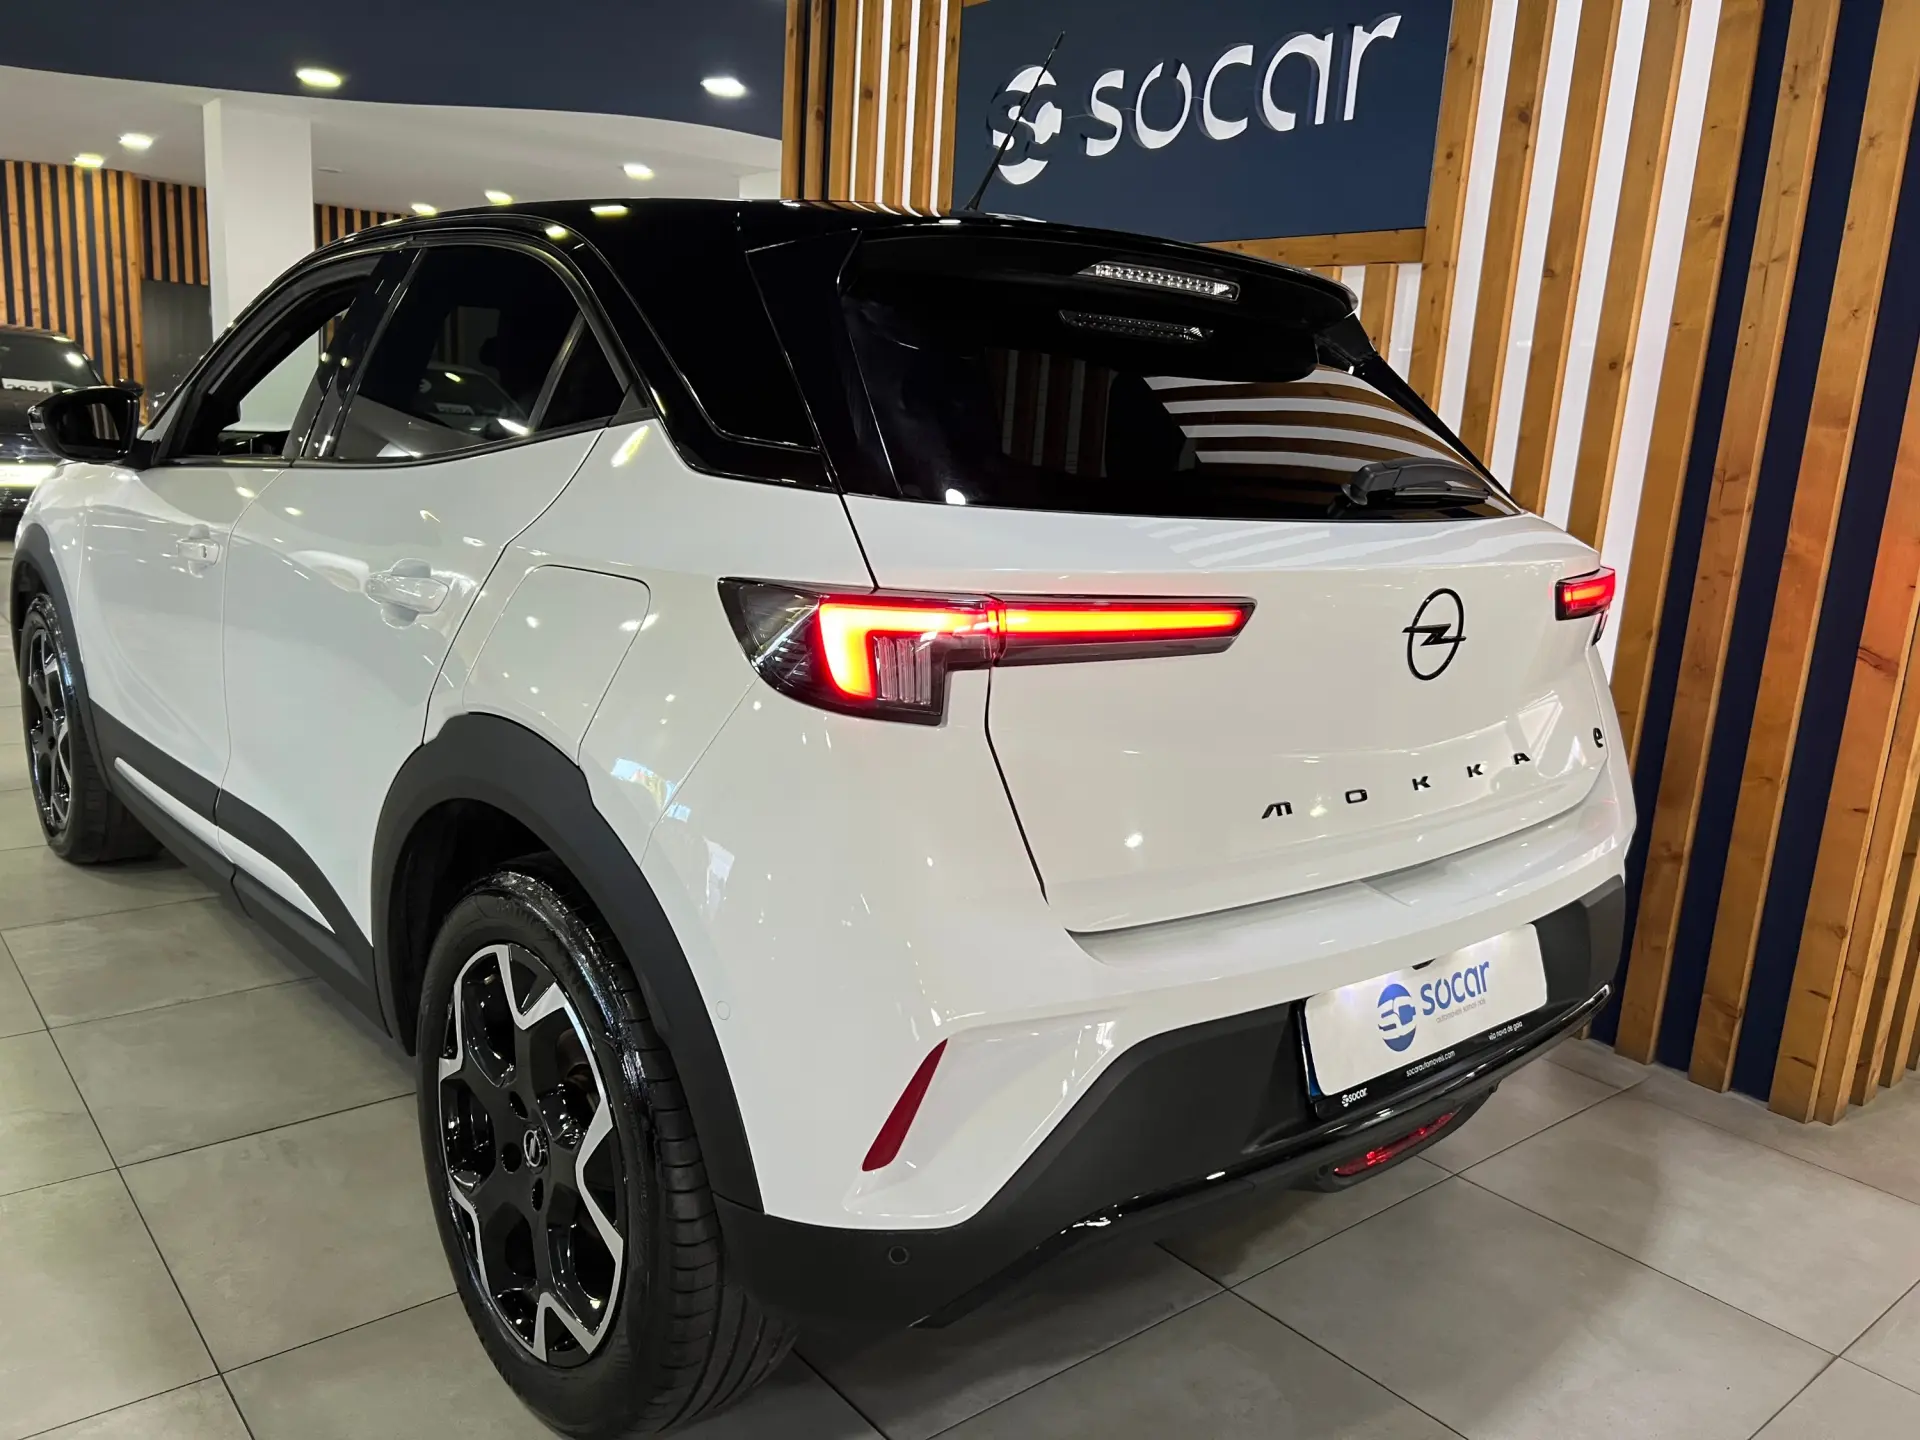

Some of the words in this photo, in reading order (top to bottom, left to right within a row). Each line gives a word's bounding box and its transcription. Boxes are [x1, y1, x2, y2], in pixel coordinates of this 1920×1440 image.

[1081, 13, 1402, 157] socar
[1261, 751, 1531, 819] MOKKA
[1420, 961, 1489, 1016] socar
[1348, 1087, 1368, 1103] socar
